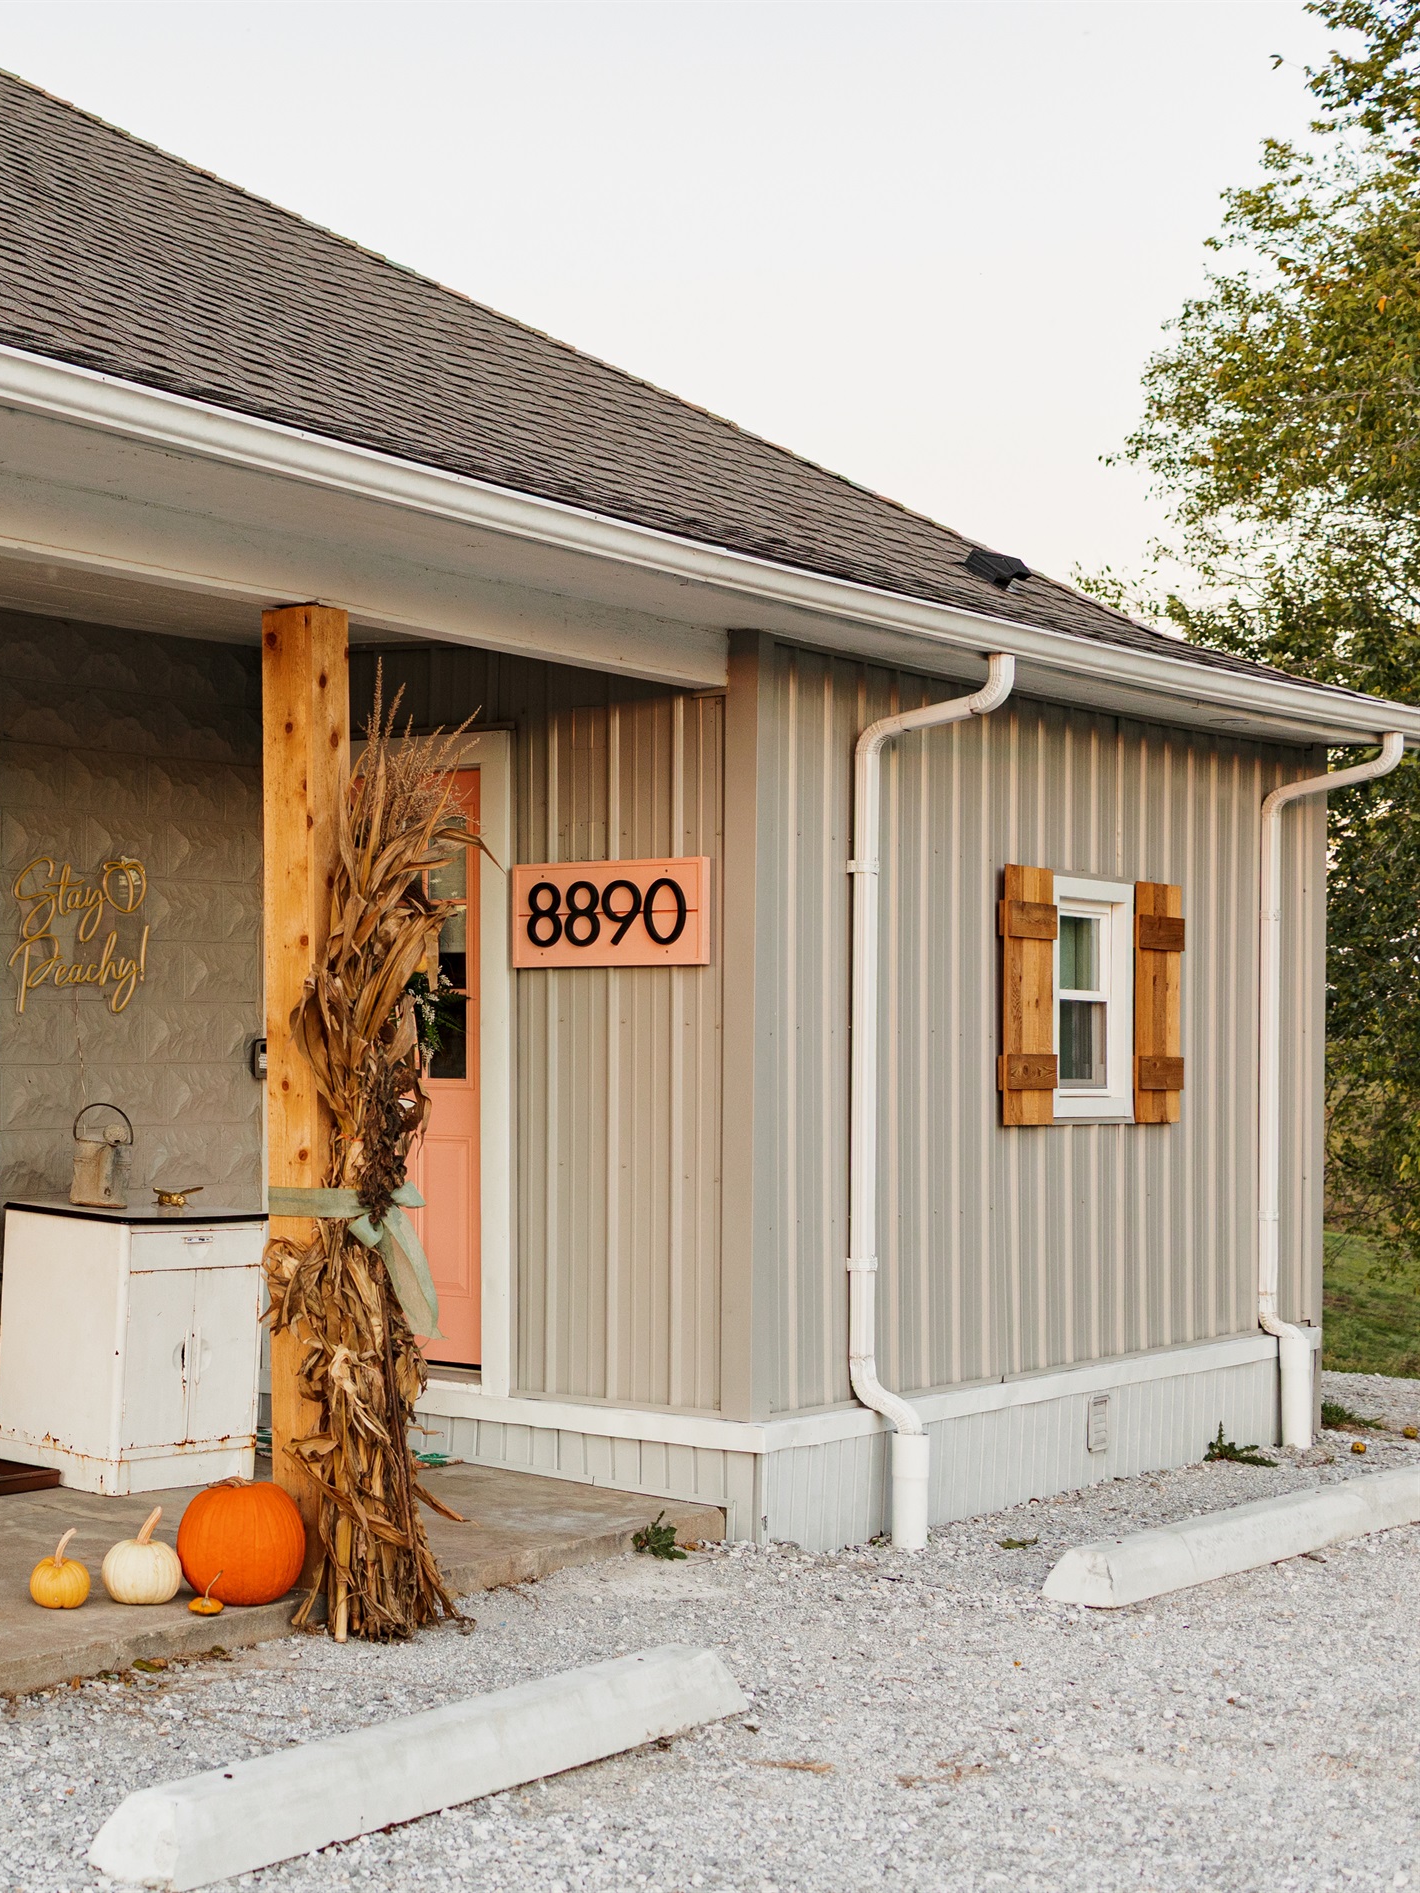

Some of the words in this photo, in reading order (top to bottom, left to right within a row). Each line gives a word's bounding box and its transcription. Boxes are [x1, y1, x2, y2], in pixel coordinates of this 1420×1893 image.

[13, 856, 107, 942] Stay
[527, 878, 687, 948] 8890
[9, 925, 149, 1013] Peachy!
